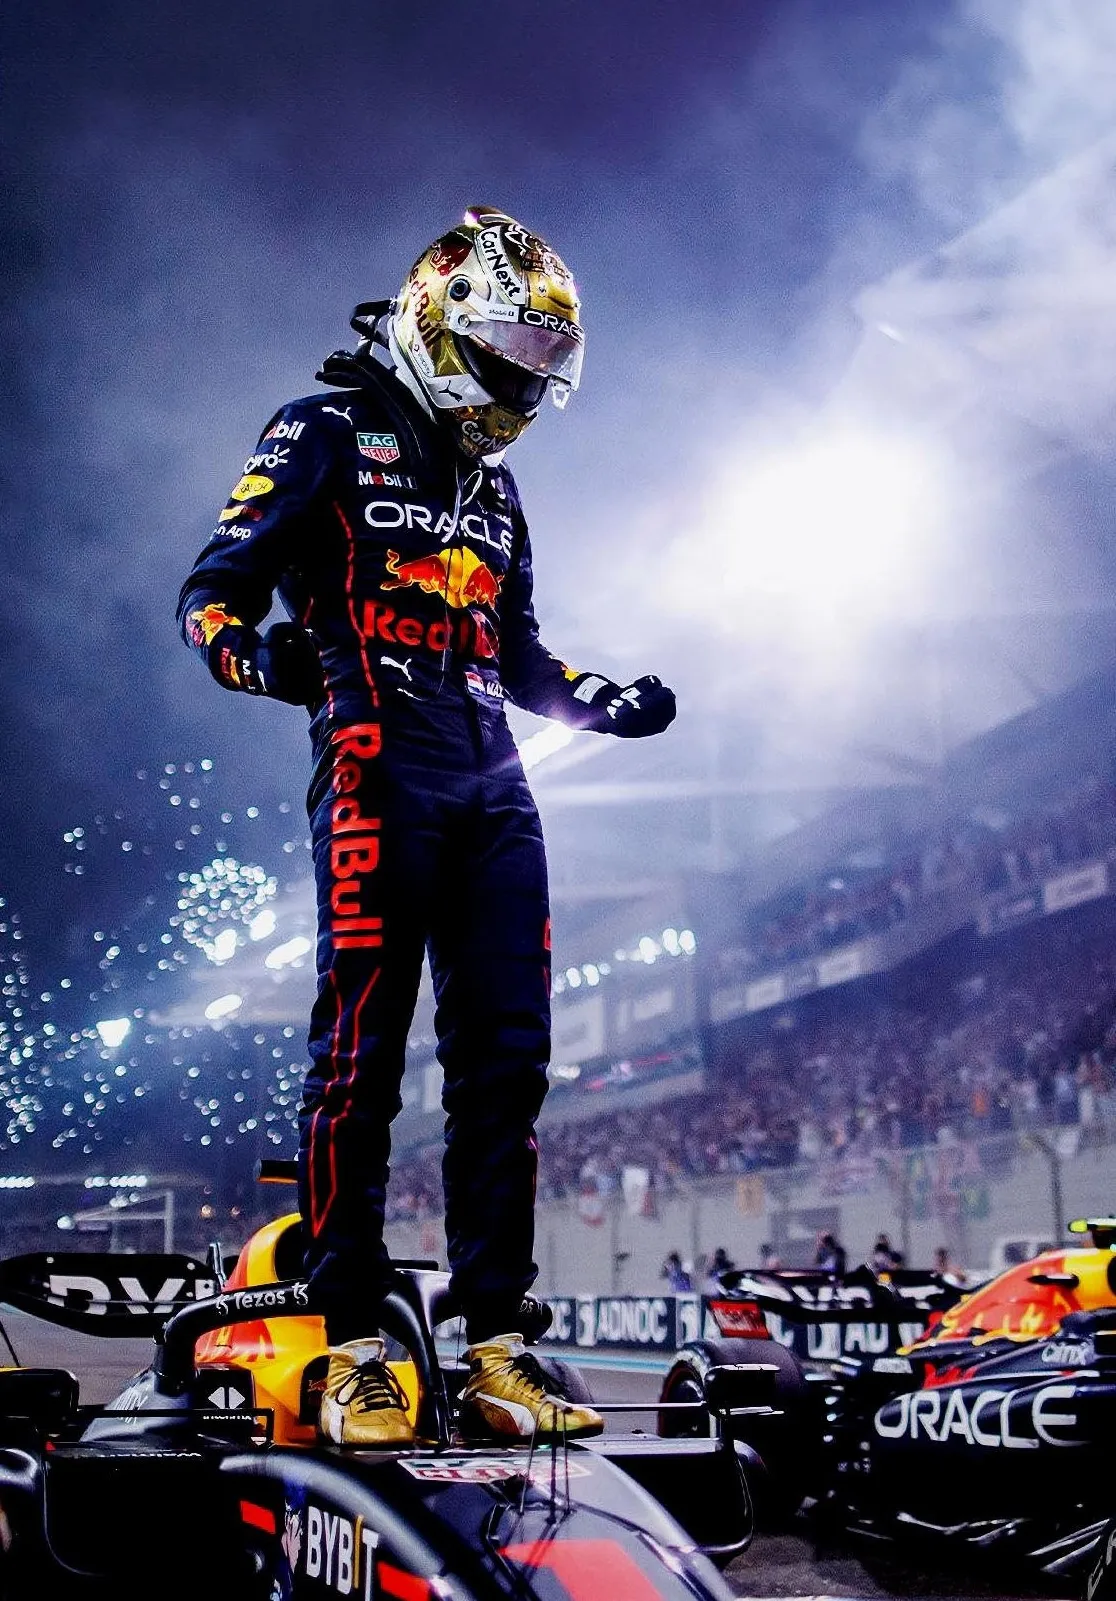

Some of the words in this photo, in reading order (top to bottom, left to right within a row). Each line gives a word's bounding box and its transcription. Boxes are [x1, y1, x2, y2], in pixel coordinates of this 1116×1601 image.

[480, 231, 521, 298] CarNext
[263, 421, 306, 440] bil
[360, 435, 394, 446] TAG
[461, 420, 505, 451] CarN
[358, 471, 401, 486] Mobil
[226, 525, 251, 540] App
[364, 501, 513, 559] ORACLE
[234, 1290, 286, 1311] Tezos
[874, 1385, 1087, 1449] ORACLE
